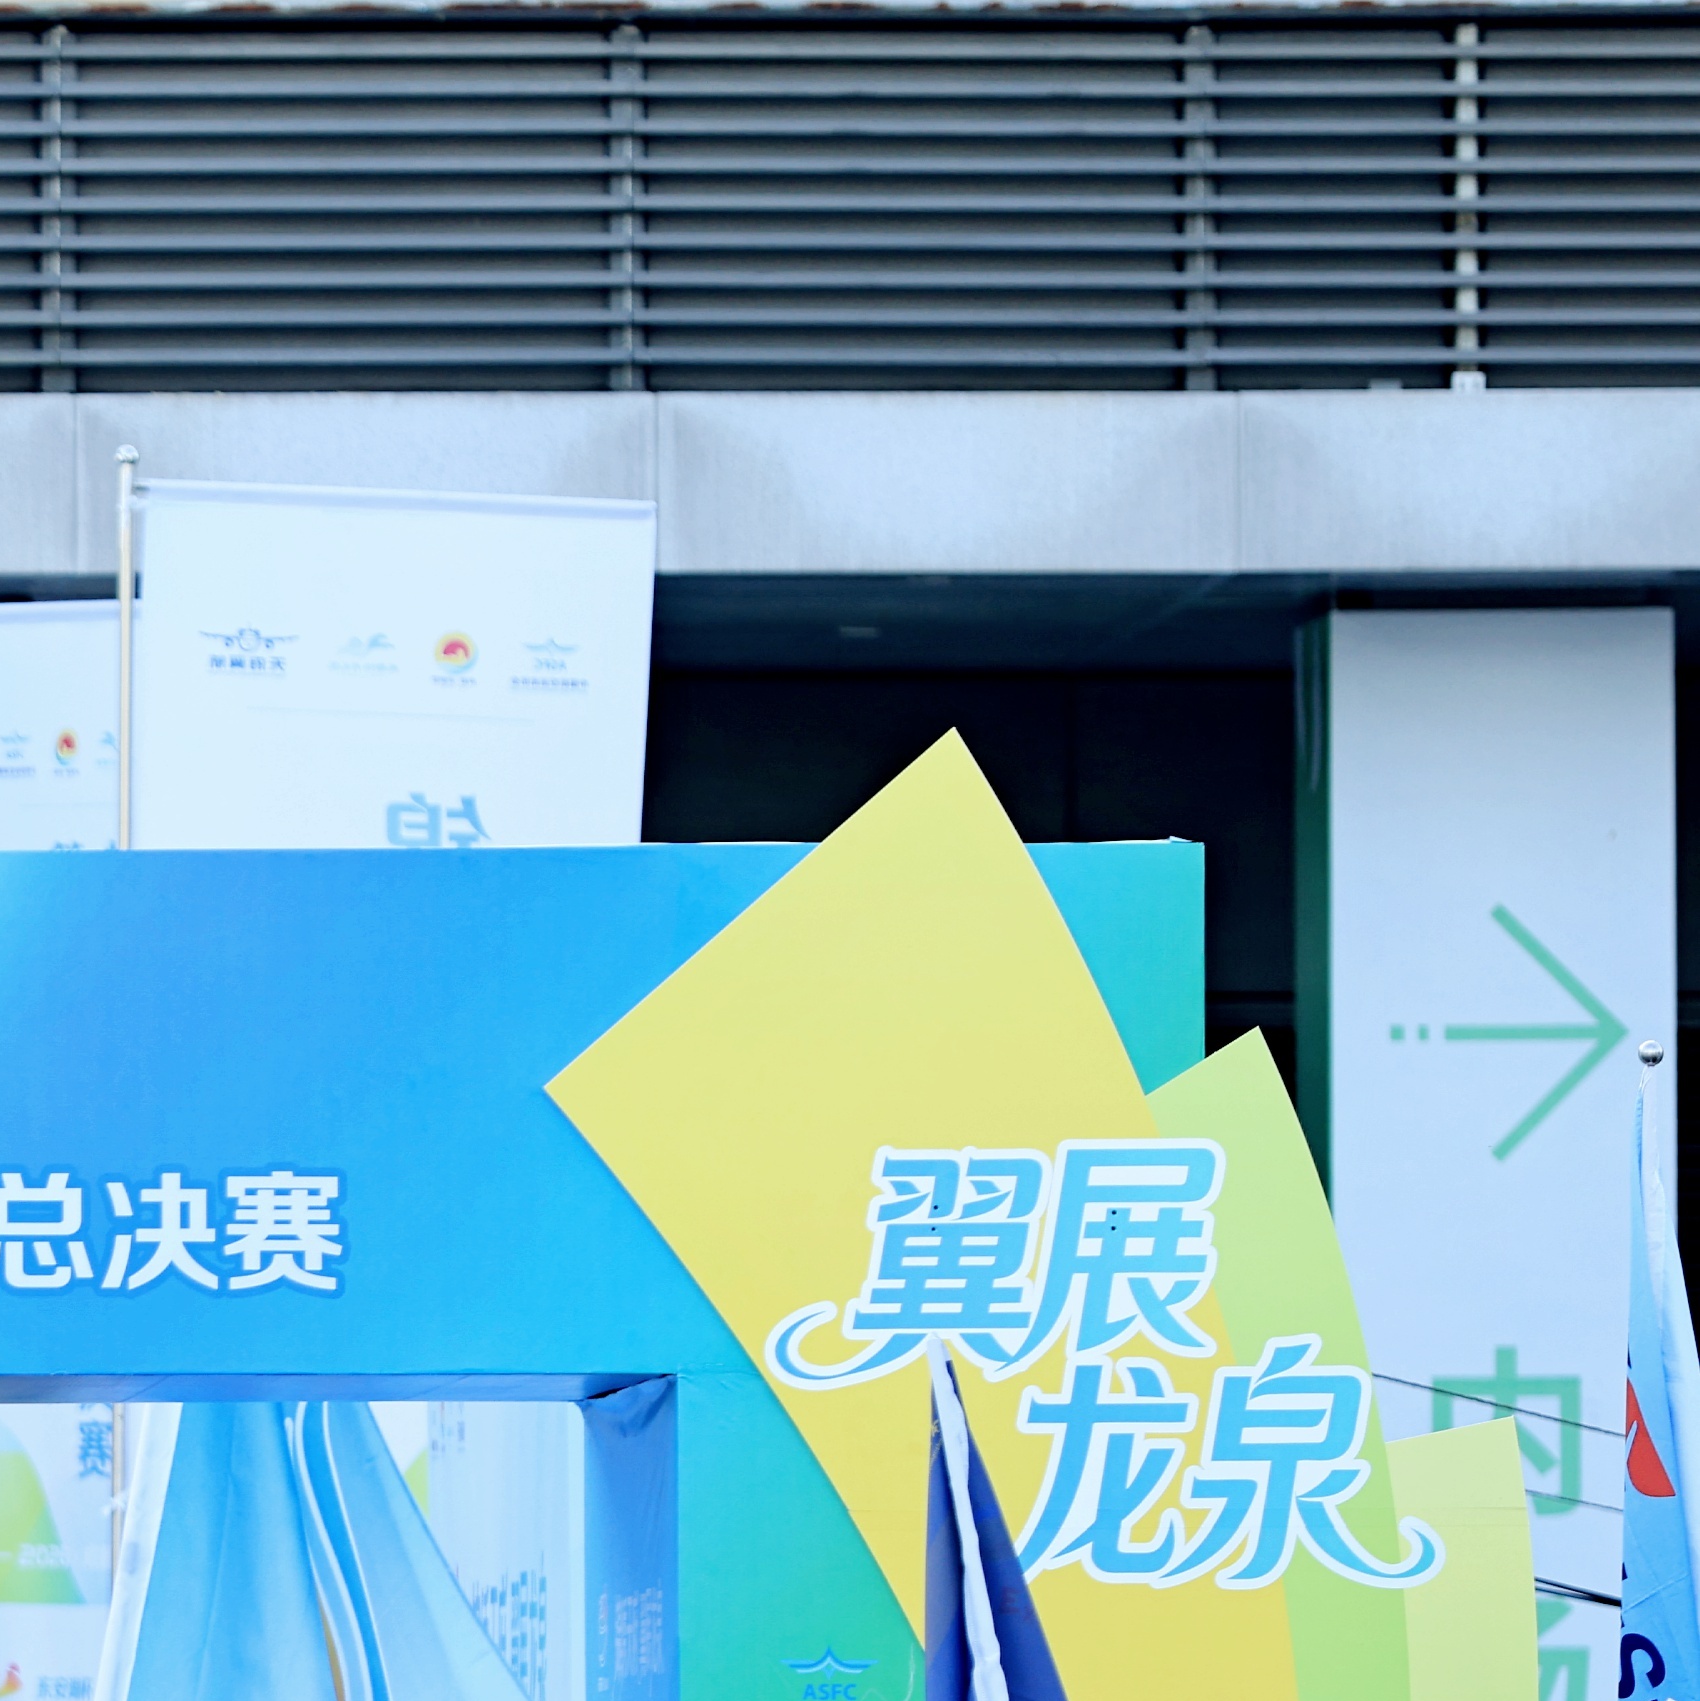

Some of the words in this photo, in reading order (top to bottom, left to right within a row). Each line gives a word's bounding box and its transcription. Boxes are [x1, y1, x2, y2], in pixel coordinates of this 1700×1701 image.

[772, 1145, 1220, 1382] 翼展
[1015, 1340, 1438, 1584] 龙泉
[803, 1684, 857, 1700] ASFC
